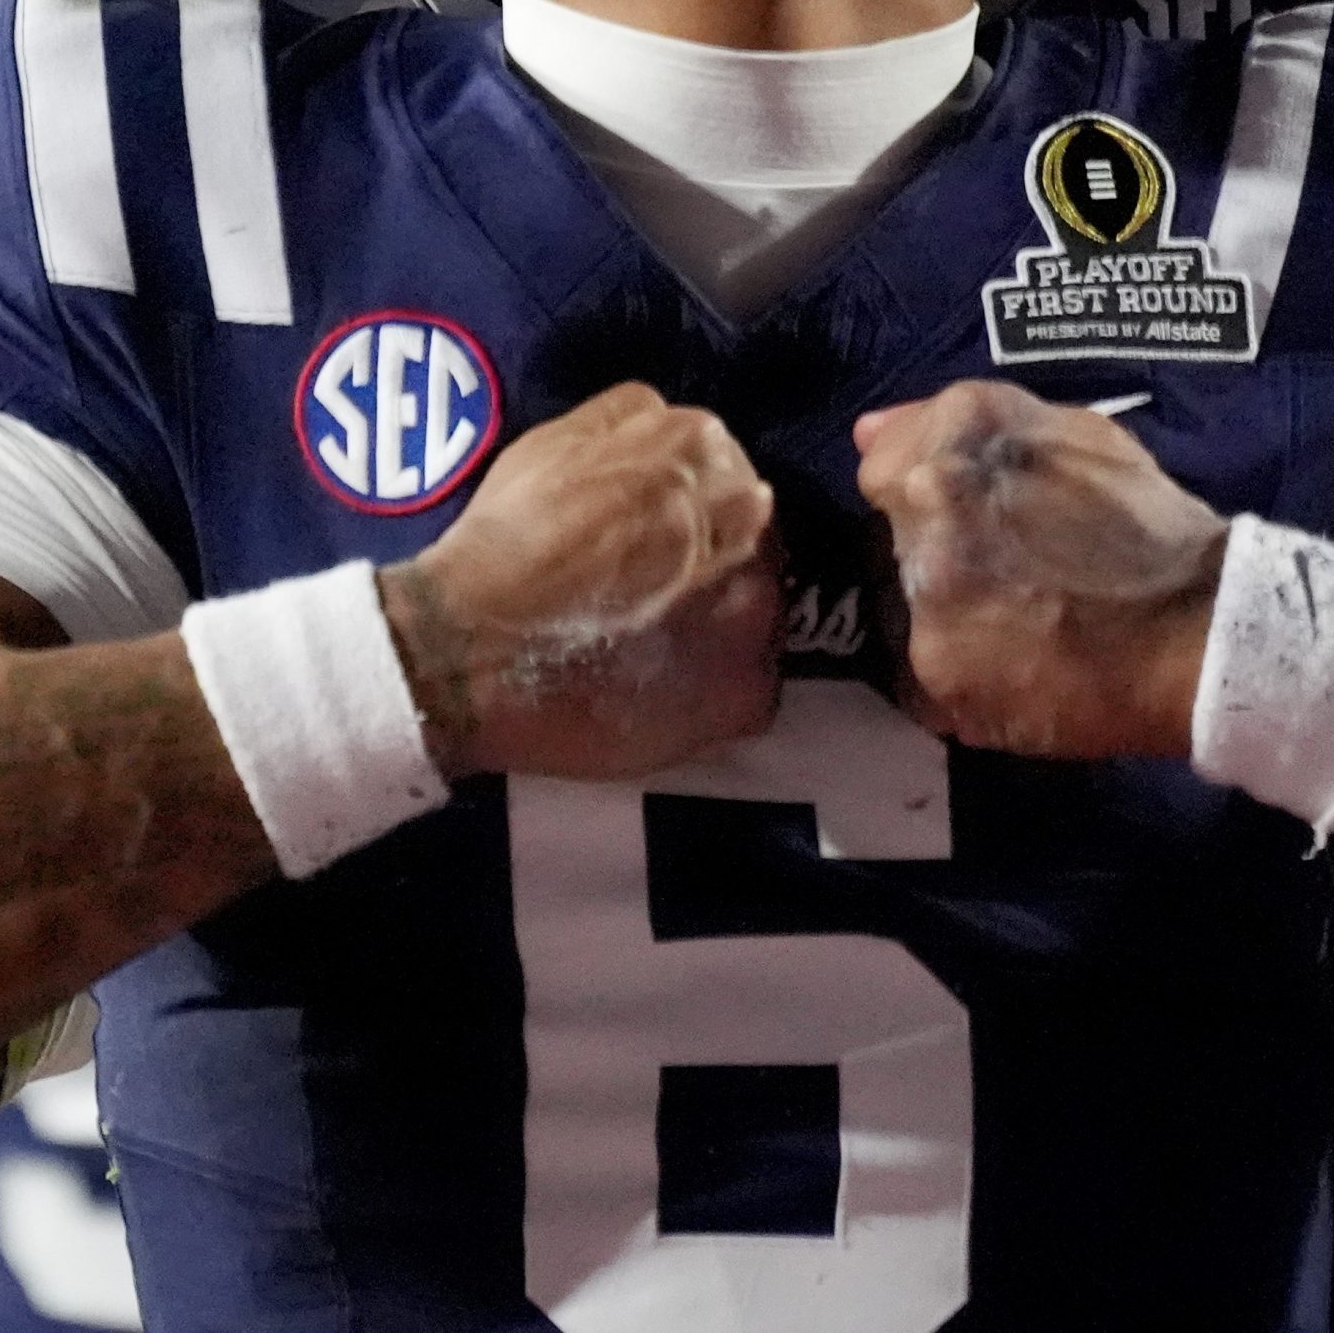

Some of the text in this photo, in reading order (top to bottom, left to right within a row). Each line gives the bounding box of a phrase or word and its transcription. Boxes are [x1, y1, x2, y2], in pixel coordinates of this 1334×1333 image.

[1035, 252, 1195, 288] PLAYOFF
[1001, 283, 1238, 321] FIRST ROUND
[1025, 322, 1222, 343] PRESENTED BY Allstate
[312, 322, 481, 500] SEC
[505, 677, 975, 1333] 6
